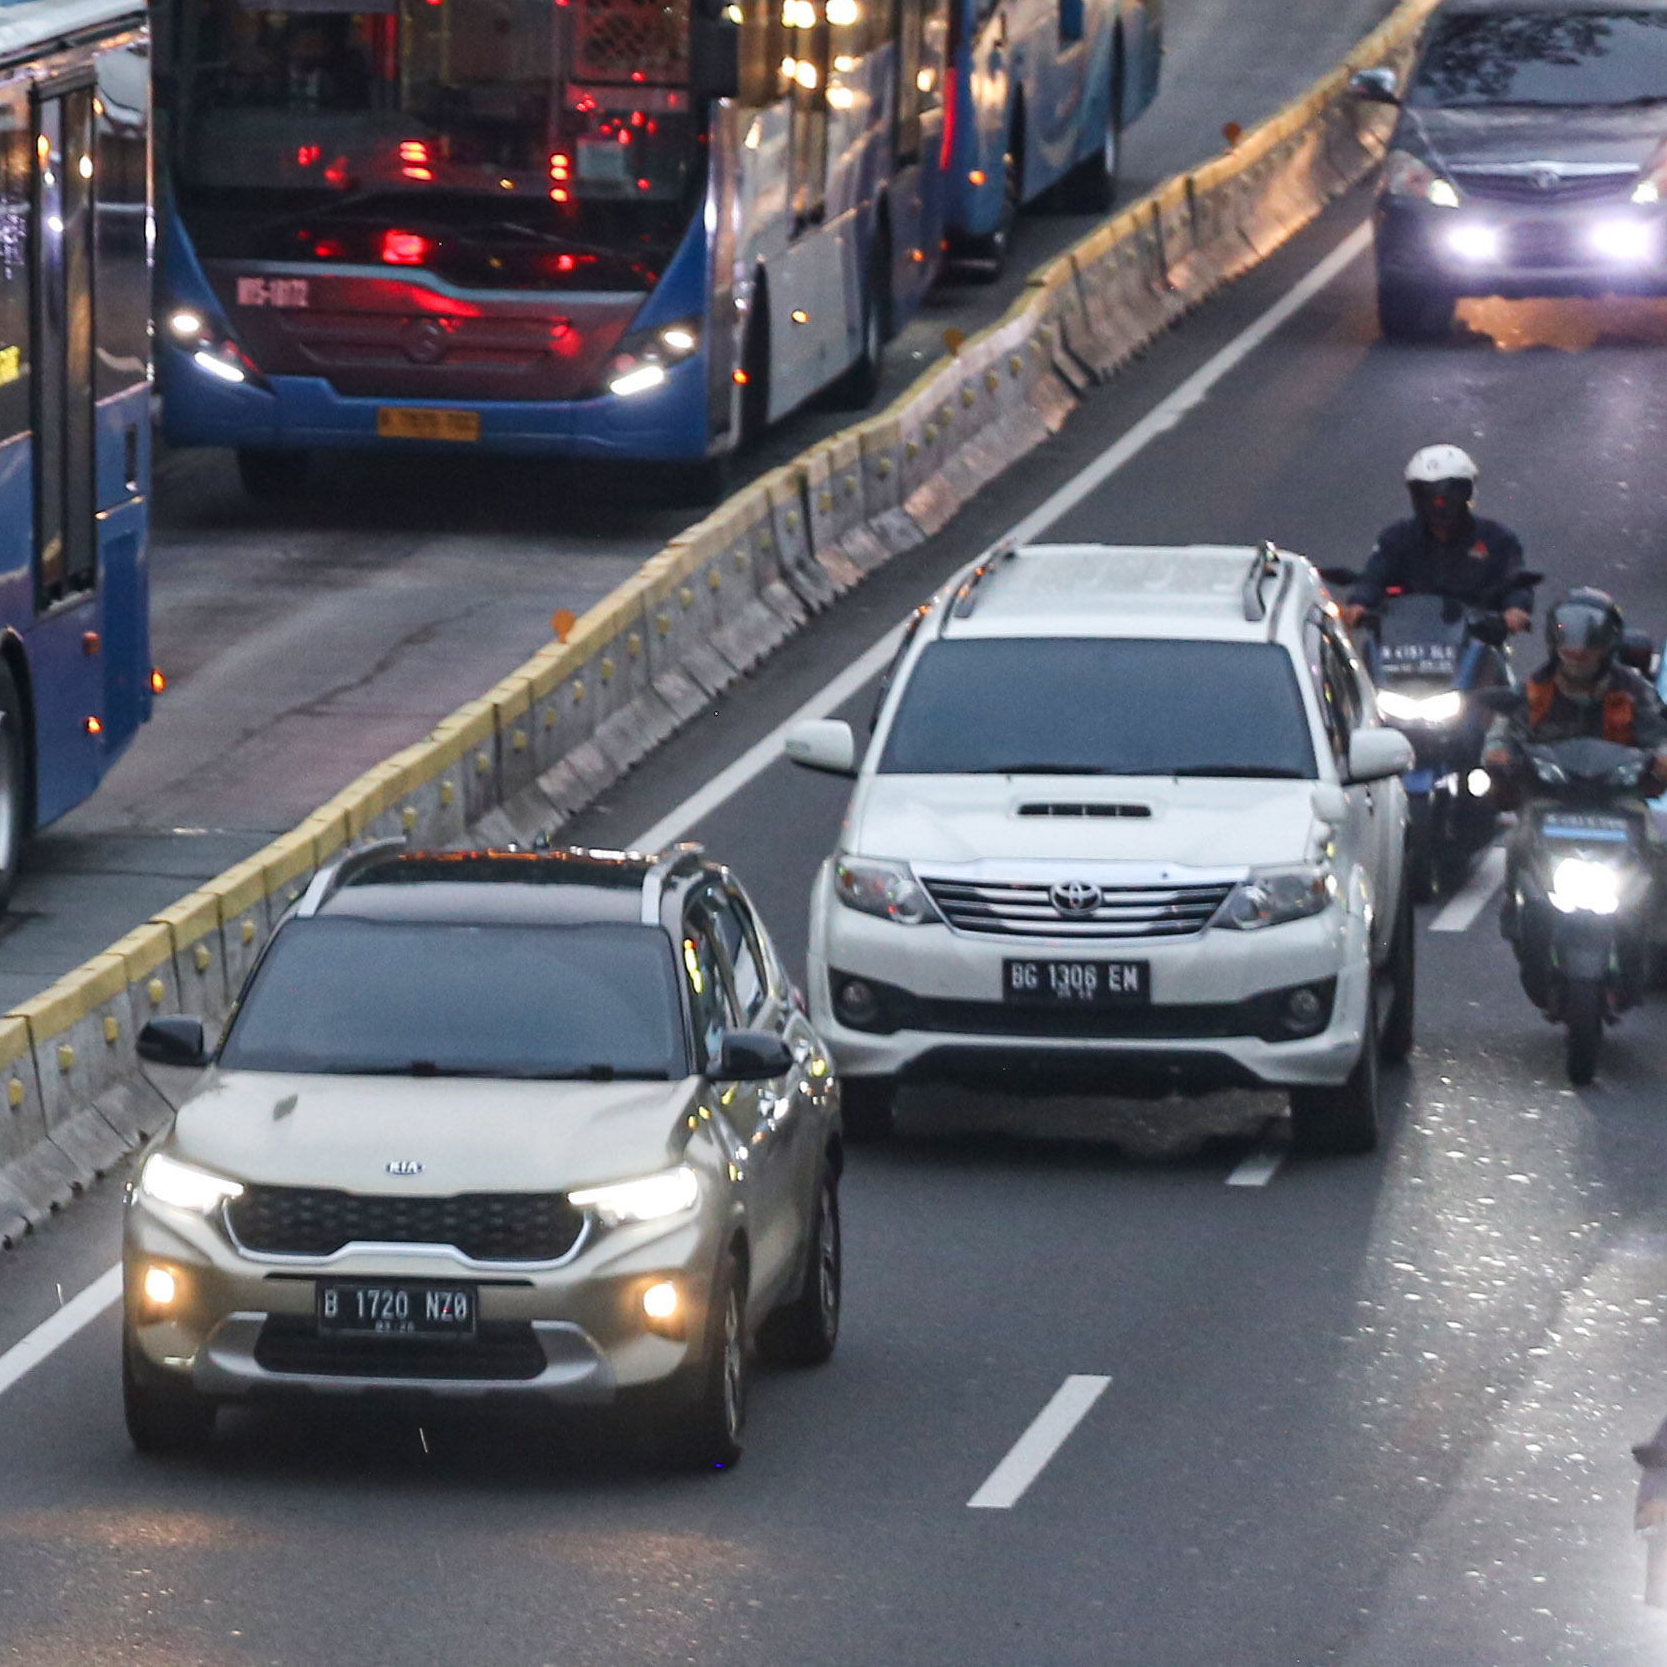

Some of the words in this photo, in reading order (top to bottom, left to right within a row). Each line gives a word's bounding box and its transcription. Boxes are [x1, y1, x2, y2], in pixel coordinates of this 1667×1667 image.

[1011, 961, 1038, 989] BG
[1047, 963, 1097, 990] 1306
[324, 1288, 338, 1318] B
[356, 1289, 409, 1319] 1720
